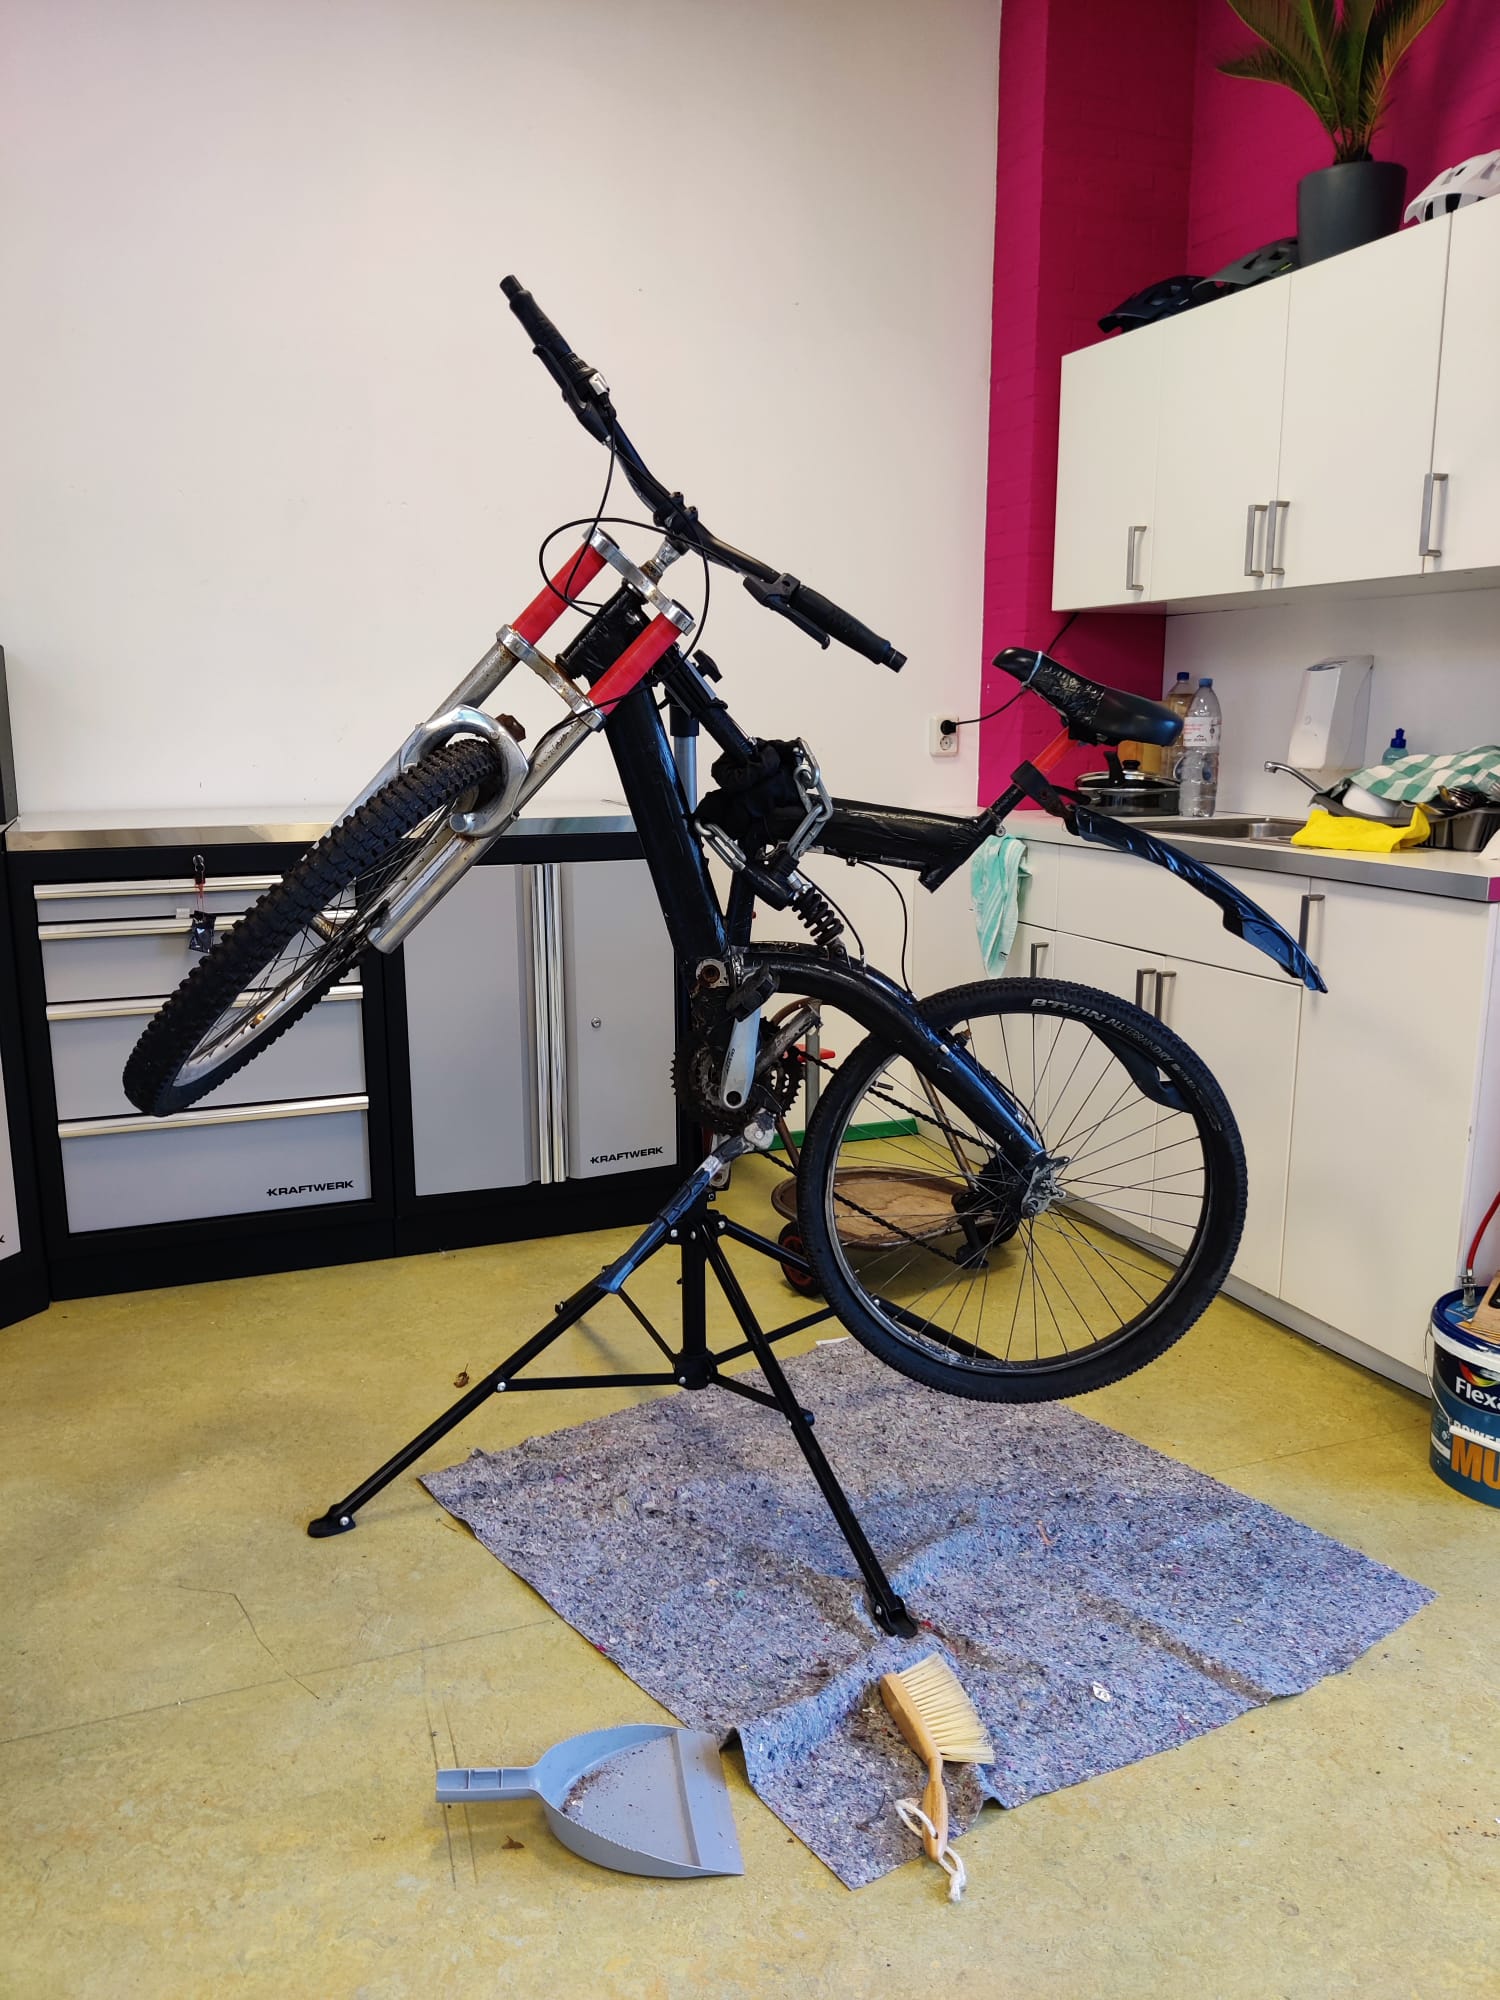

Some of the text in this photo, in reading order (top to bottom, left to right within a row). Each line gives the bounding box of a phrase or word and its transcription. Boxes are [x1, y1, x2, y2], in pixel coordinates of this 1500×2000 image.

[590, 1146, 664, 1165] KRAFTWERK
[266, 1180, 354, 1197] KRAFTWERK
[1455, 1376, 1500, 1411] Flex
